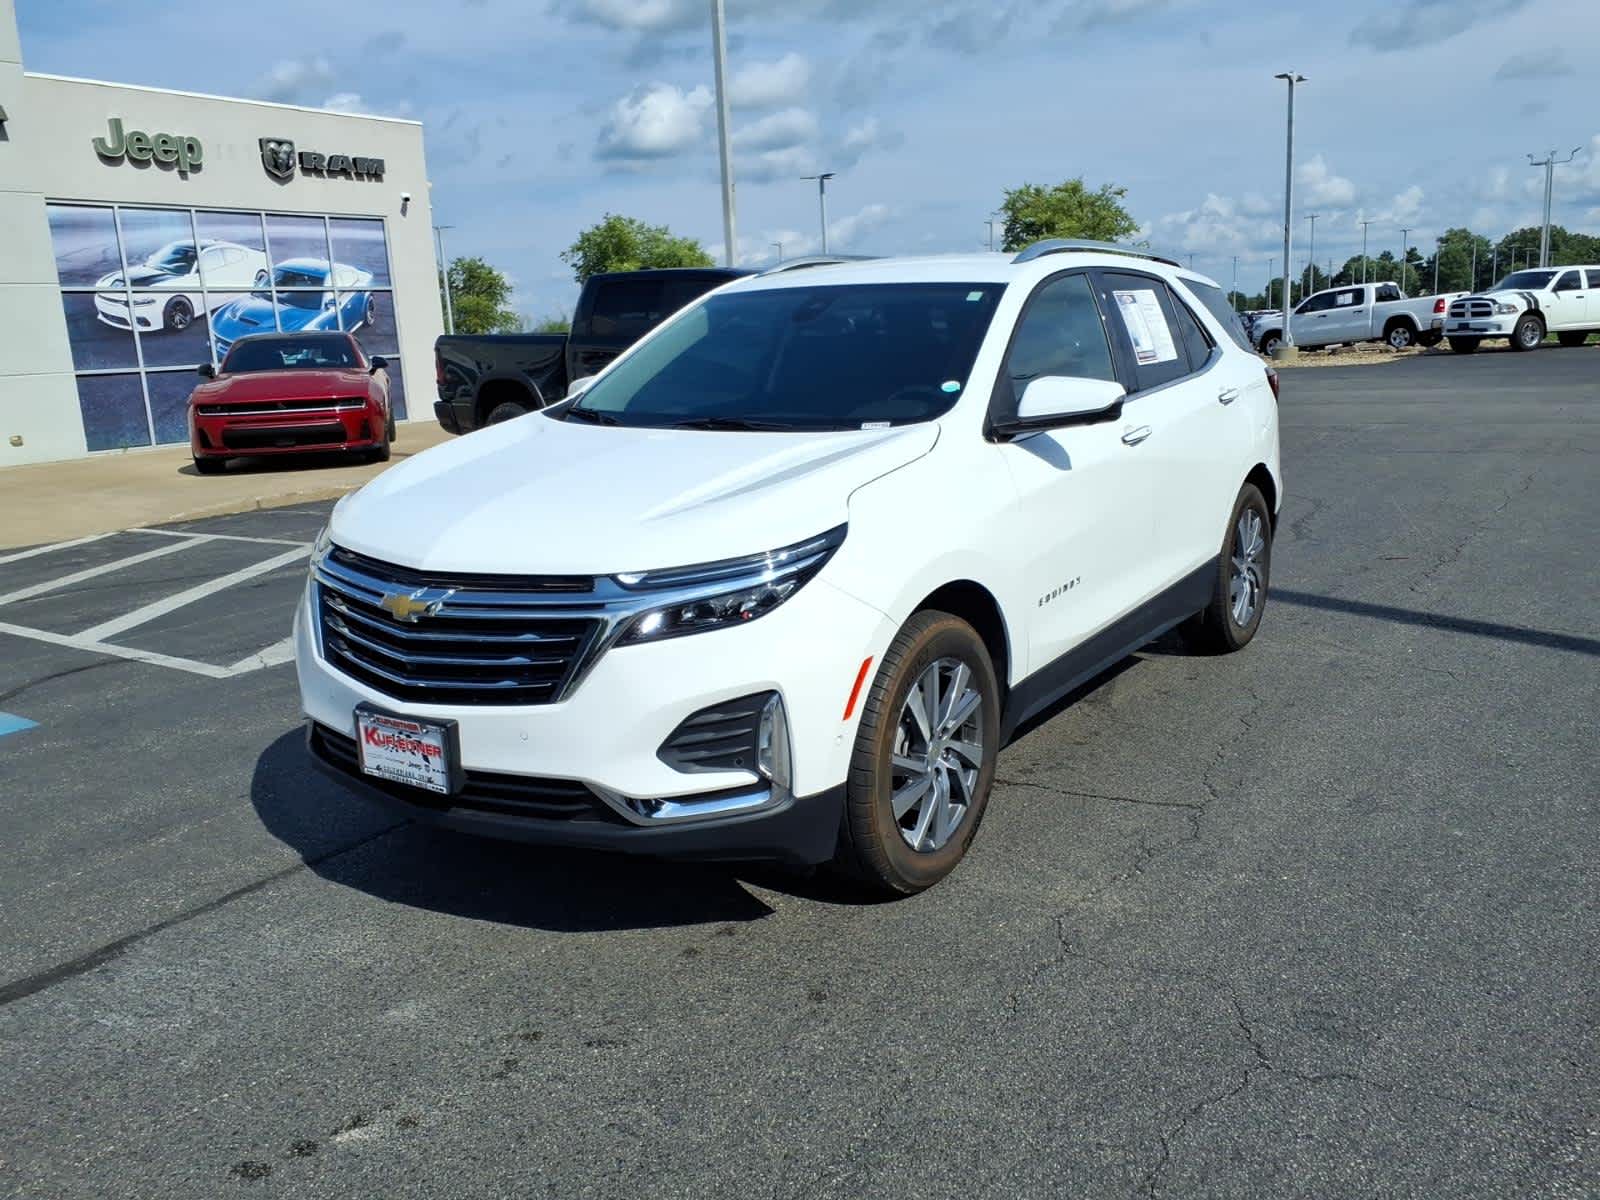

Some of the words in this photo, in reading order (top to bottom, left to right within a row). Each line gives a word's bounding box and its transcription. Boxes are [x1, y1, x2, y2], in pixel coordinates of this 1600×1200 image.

[92, 118, 203, 172] Jeep
[298, 151, 386, 175] RAM
[1038, 575, 1081, 608] EQUINOX
